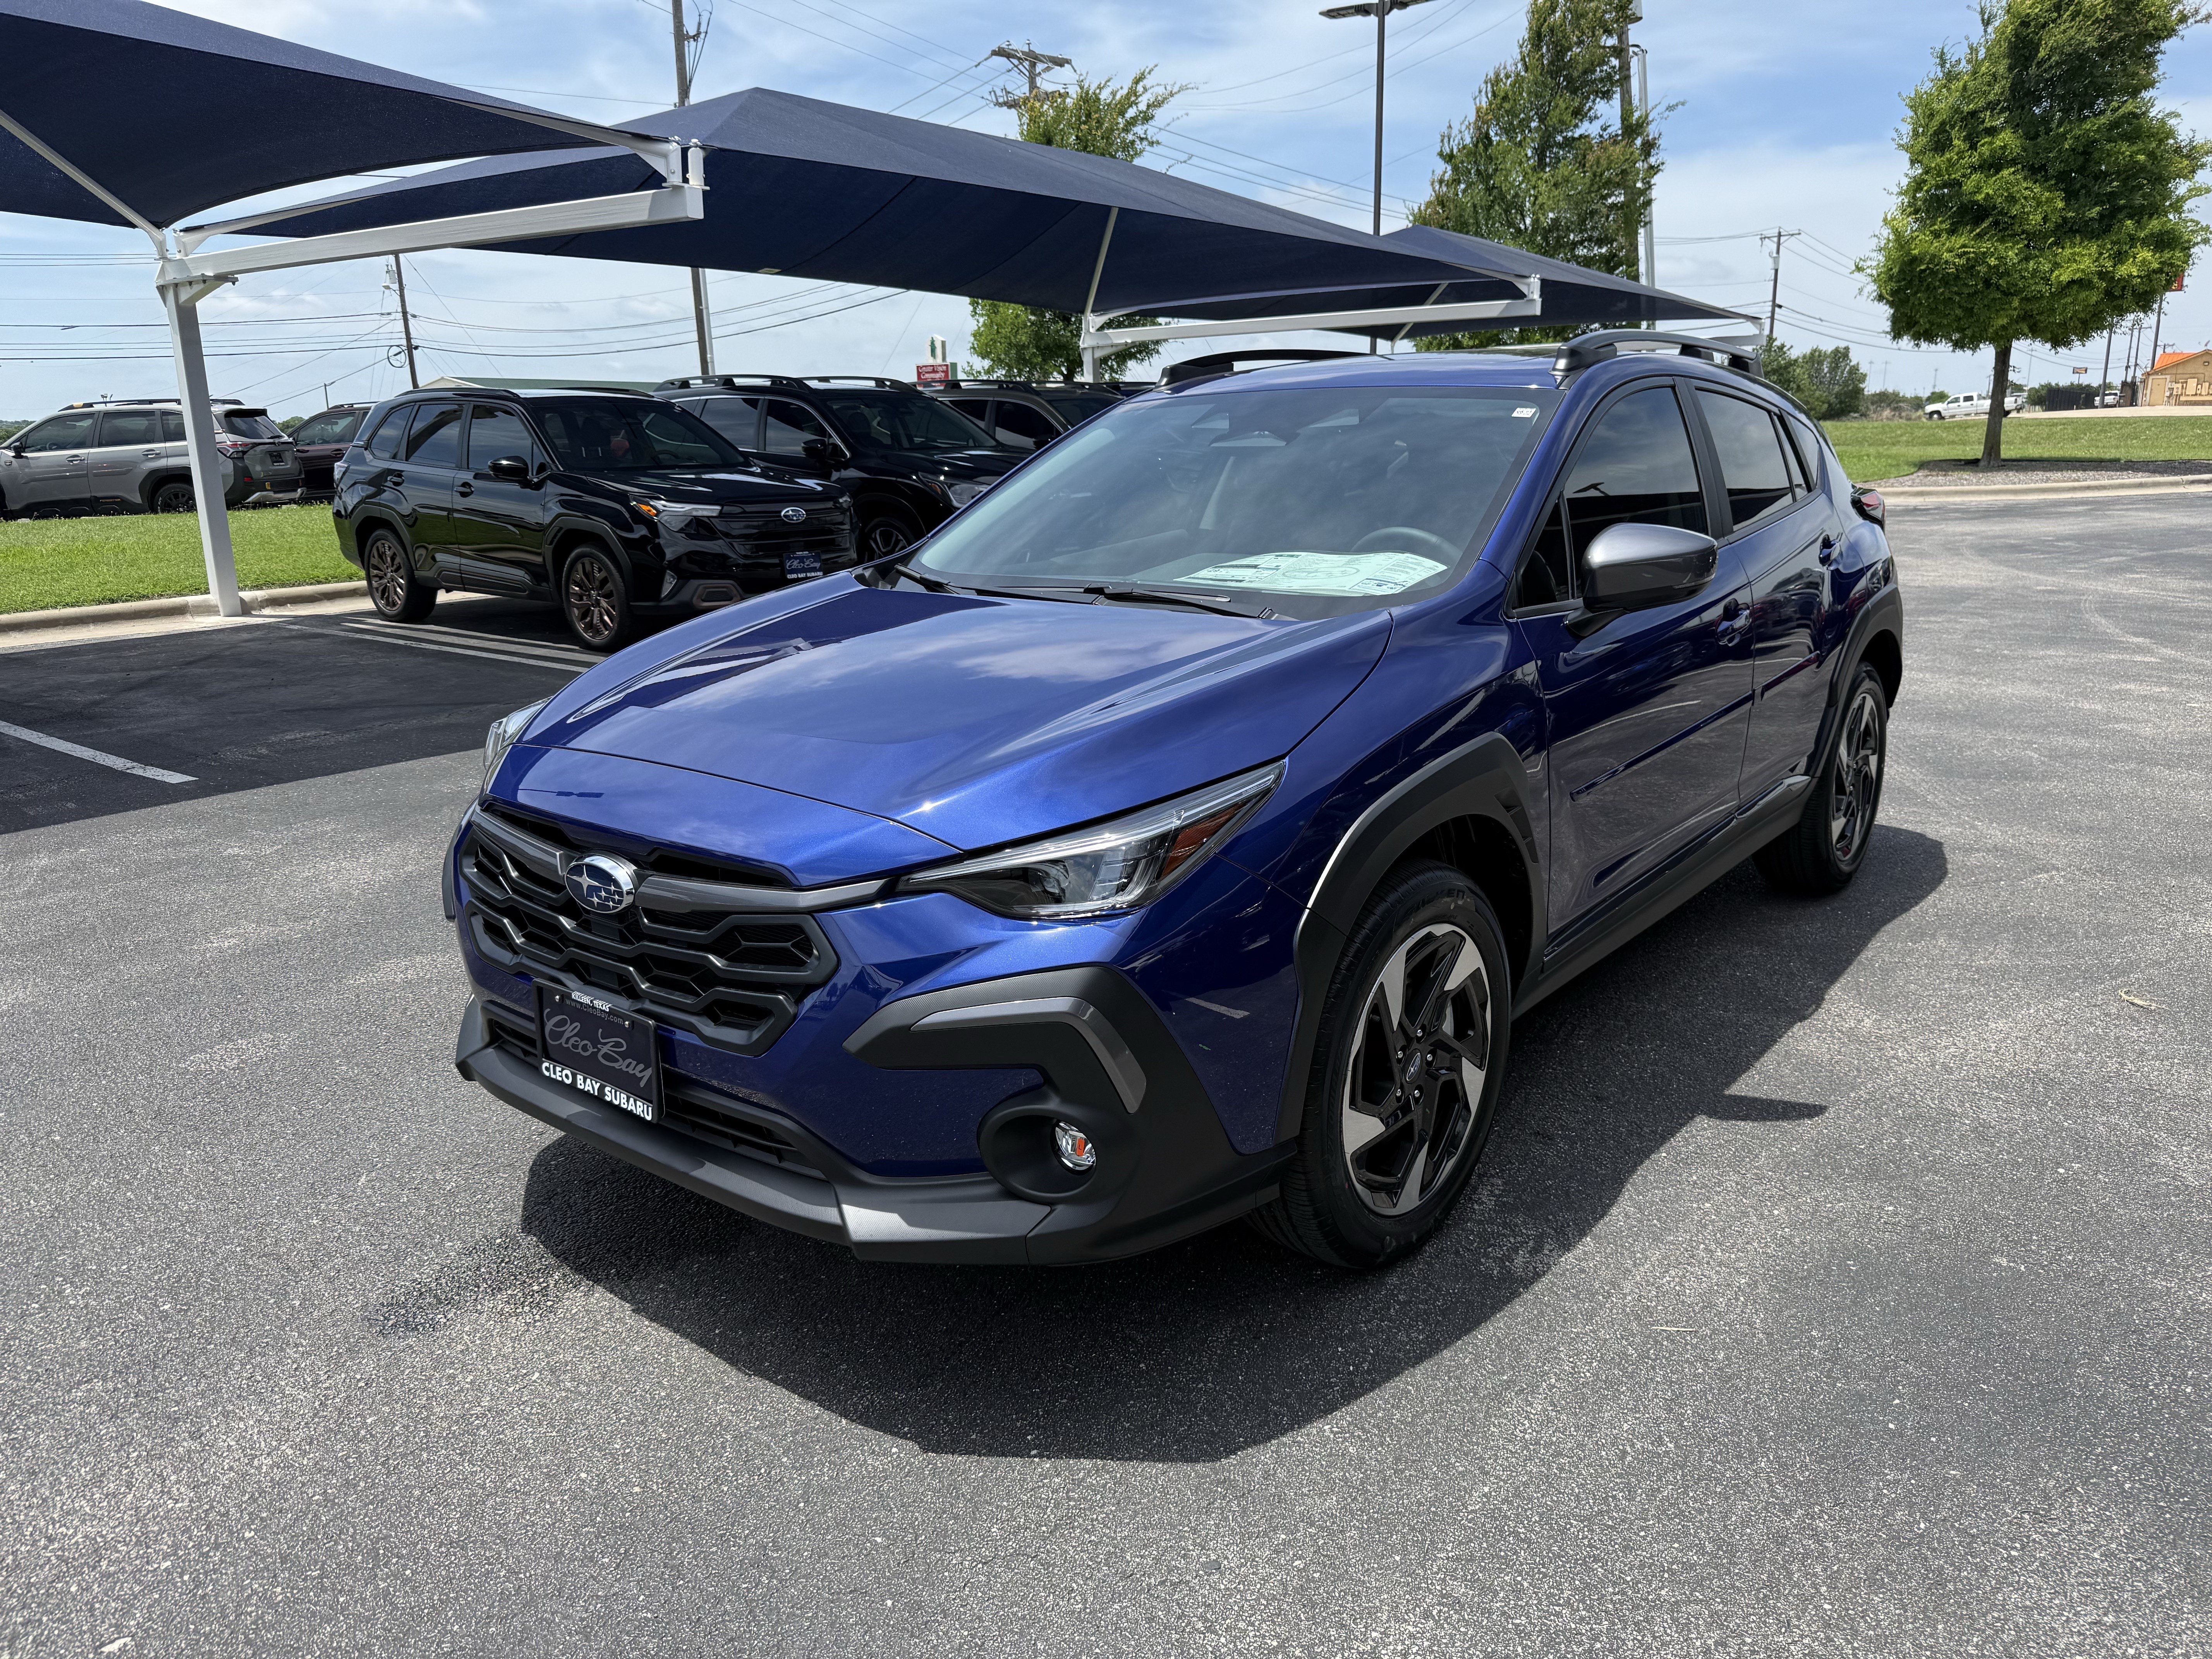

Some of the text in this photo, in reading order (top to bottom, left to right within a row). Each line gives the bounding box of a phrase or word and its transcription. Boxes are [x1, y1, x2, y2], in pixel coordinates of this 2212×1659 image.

[565, 998, 623, 1025] www.CleoBay.com
[572, 991, 613, 1012] KILLEEN, TEXAS
[544, 1008, 653, 1087] Cleo Bay
[542, 1062, 653, 1121] CLEO BAY SUBARU
